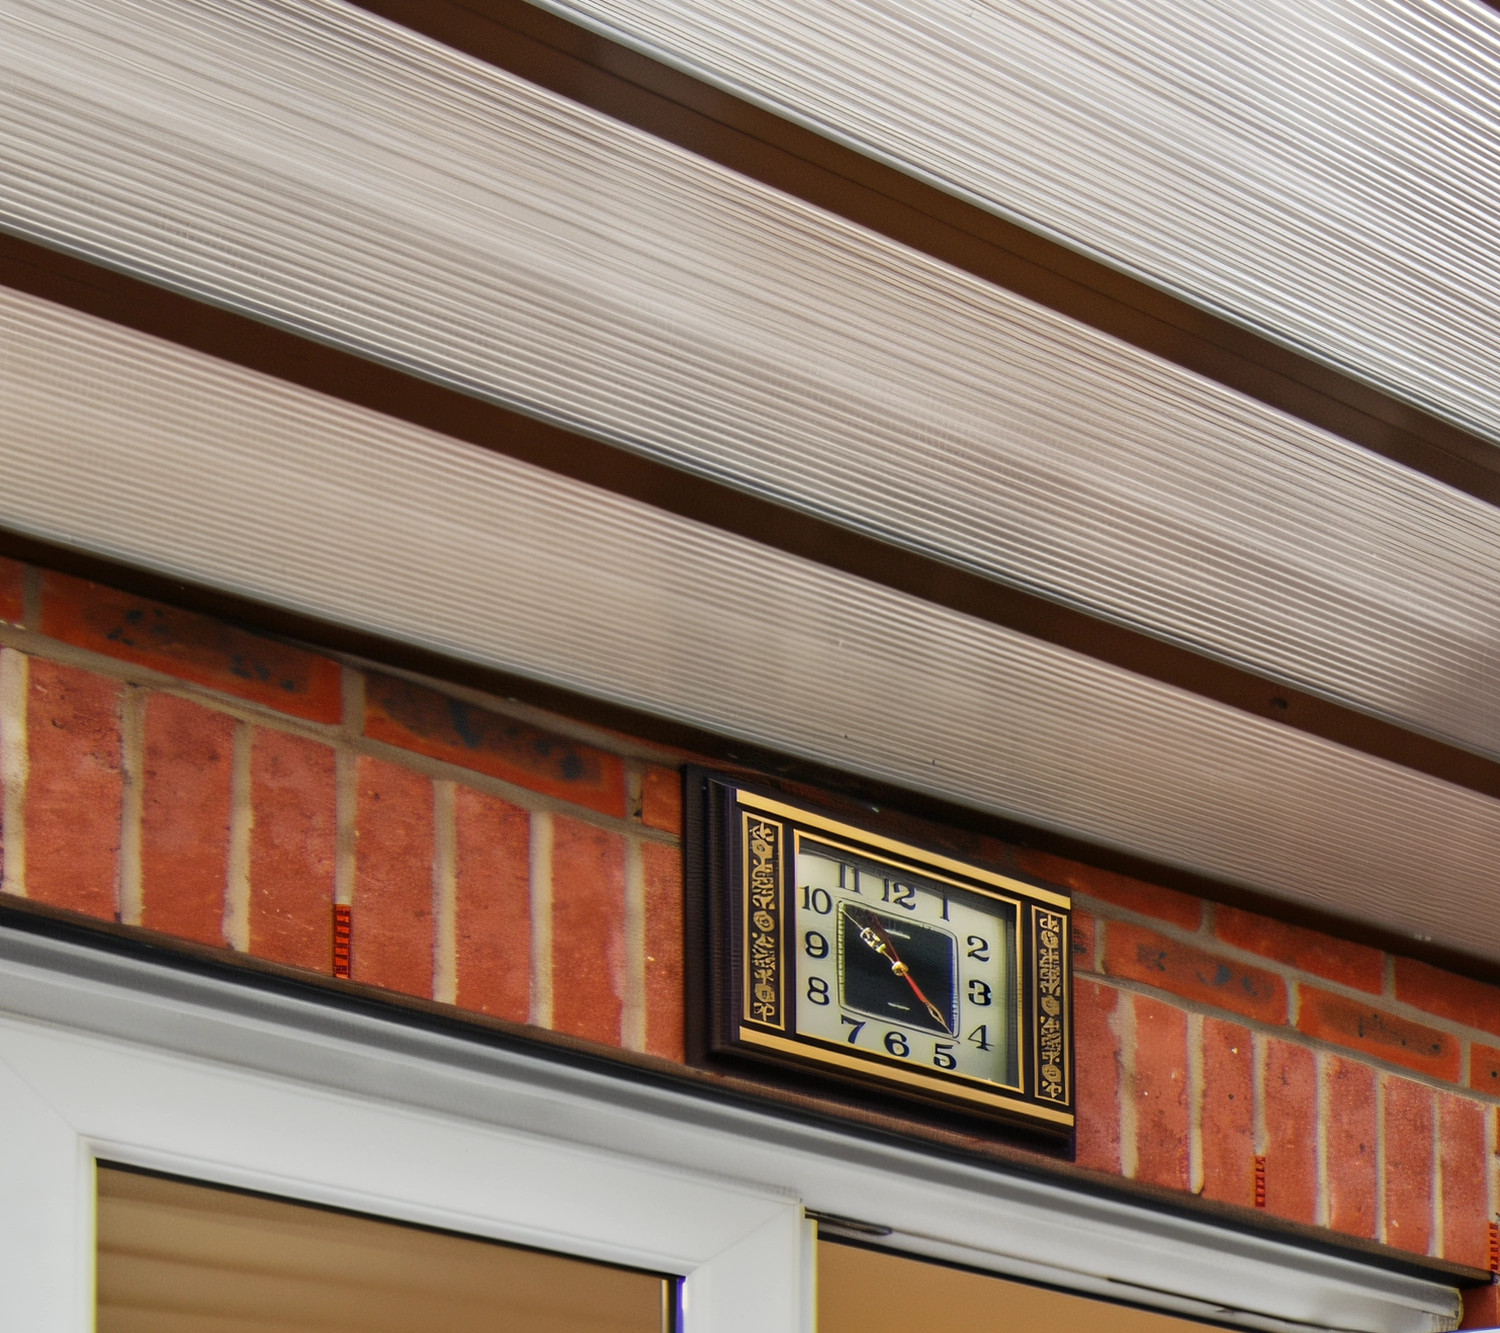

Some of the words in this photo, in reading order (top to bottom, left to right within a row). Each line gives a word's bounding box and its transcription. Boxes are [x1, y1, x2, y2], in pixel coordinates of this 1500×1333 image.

[838, 861, 862, 894] 11
[800, 885, 832, 915] 10
[881, 878, 916, 911] 12
[937, 894, 950, 922] 1
[805, 931, 829, 959] 9
[967, 935, 990, 962] 2
[807, 976, 830, 1006] 8
[968, 979, 992, 1007] 3
[841, 1014, 866, 1044] 7
[968, 1024, 995, 1051] 4
[884, 1031, 910, 1058] 6
[934, 1043, 957, 1070] 5
